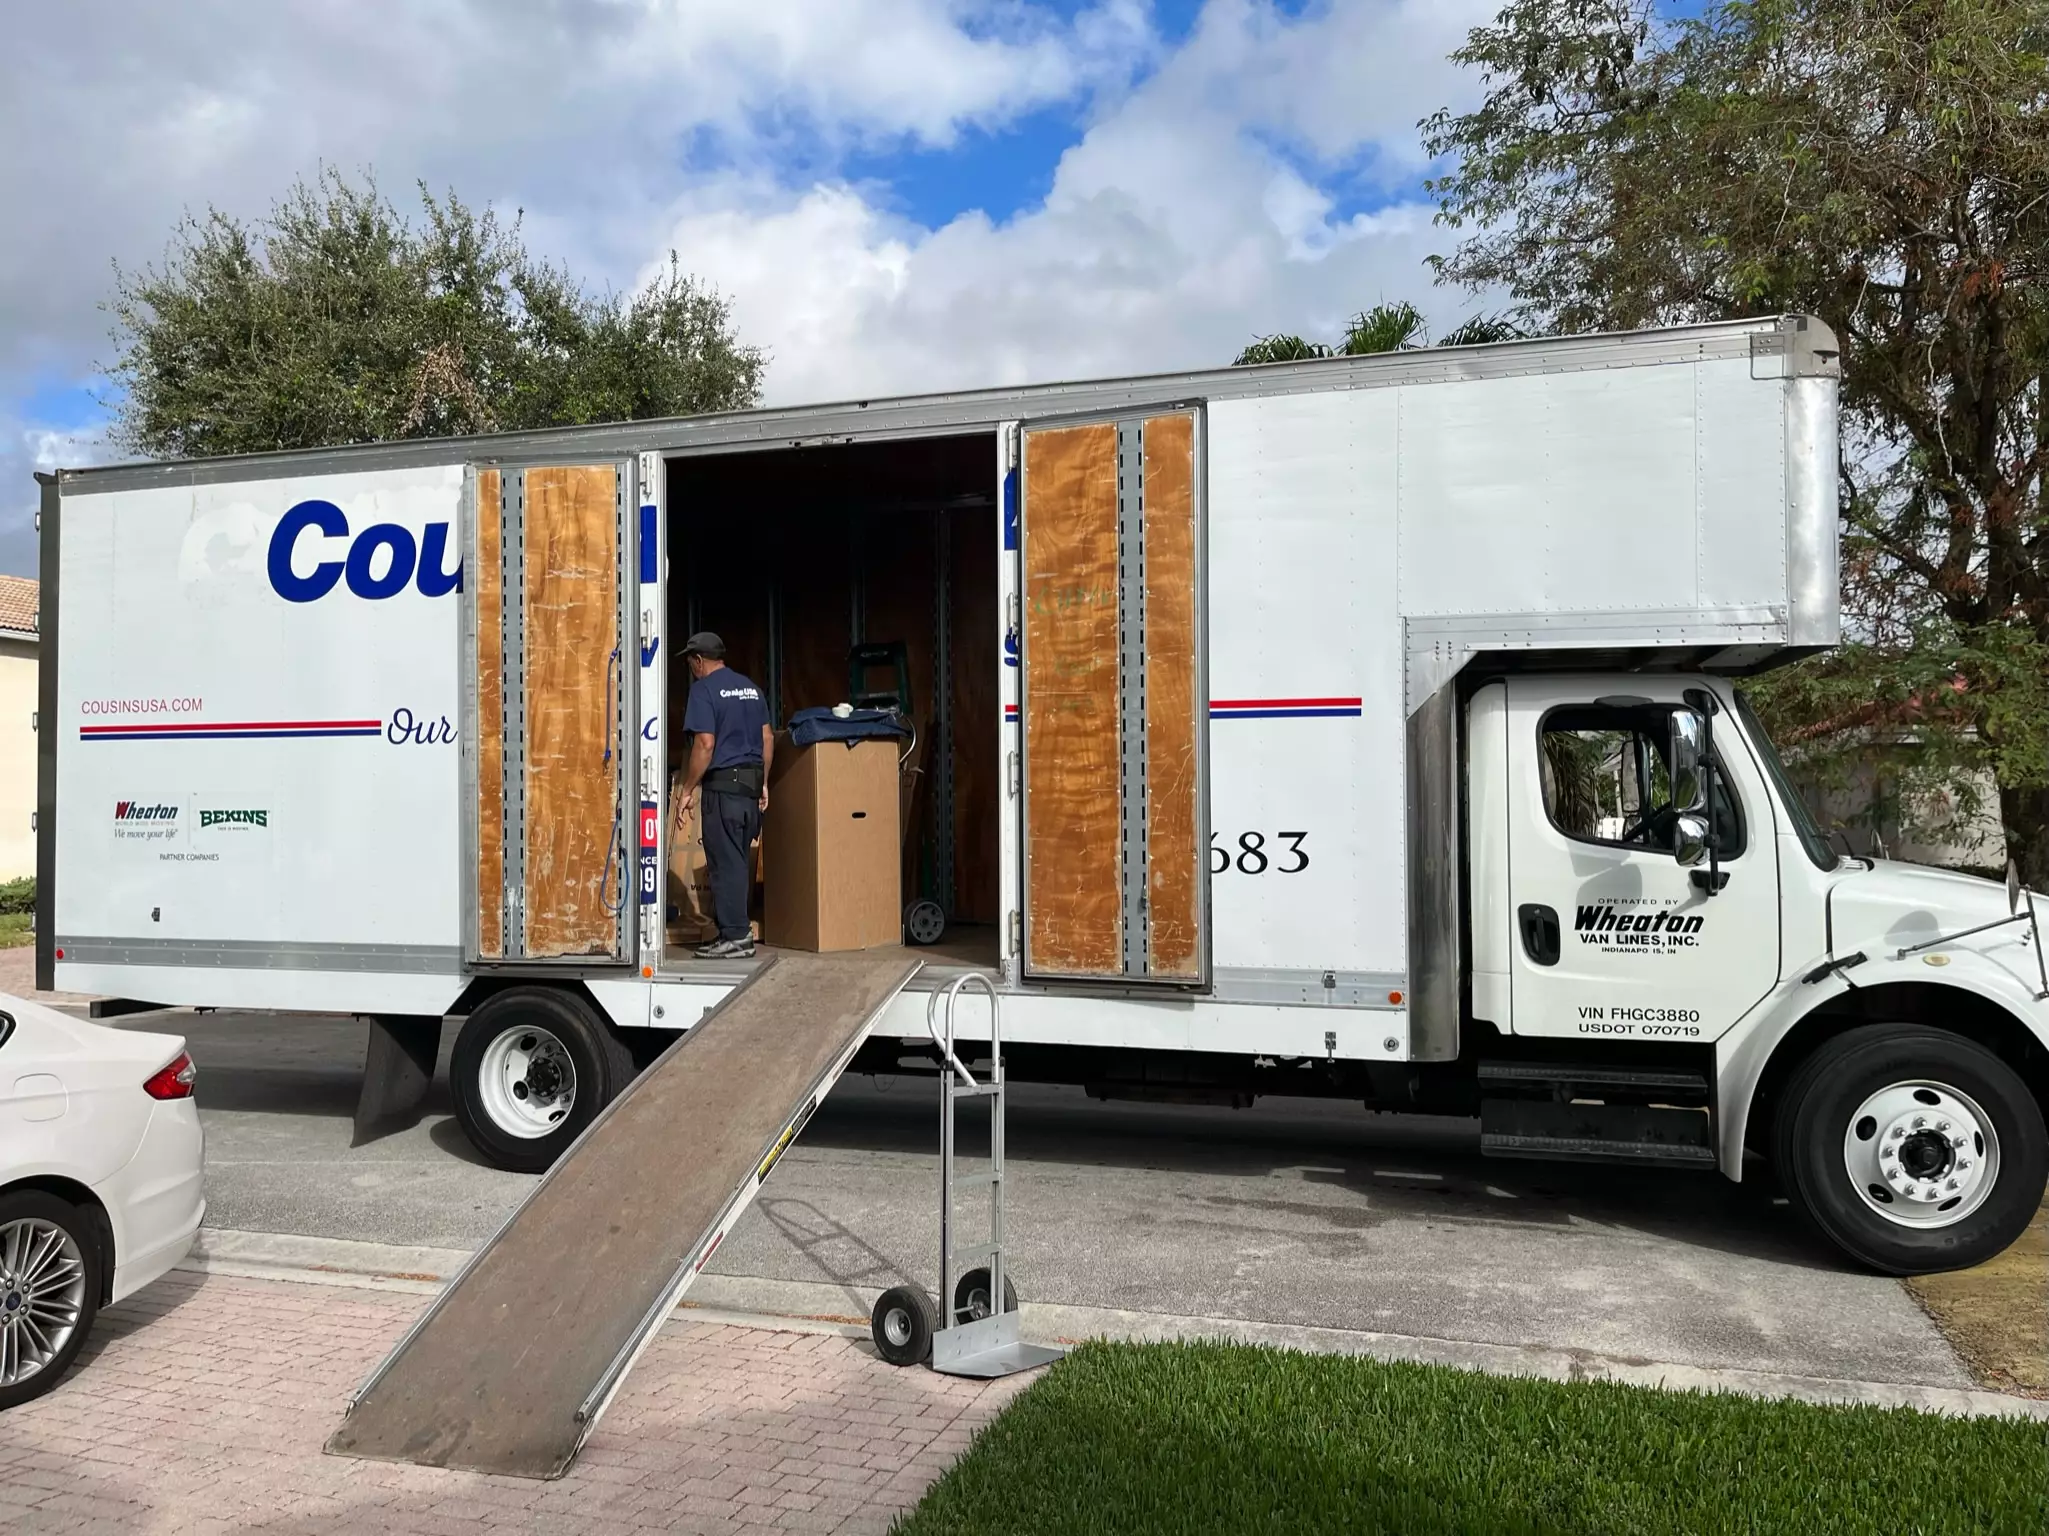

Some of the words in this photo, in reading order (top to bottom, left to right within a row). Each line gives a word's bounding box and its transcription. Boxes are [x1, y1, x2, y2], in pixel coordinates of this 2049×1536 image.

[81, 698, 203, 715] COUSINSUSA.COM
[387, 707, 458, 745] Our
[115, 801, 179, 820] Wheaton
[199, 809, 268, 828] BEKINS
[114, 828, 126, 838] We
[146, 831, 164, 841] your
[645, 818, 657, 840] O
[159, 853, 185, 861] PARTNER
[186, 853, 220, 861] COMPANIES
[640, 866, 655, 893] 9
[1597, 897, 1657, 905] OPERATED
[1574, 905, 1705, 933] Wheaton
[1580, 933, 1609, 944] VAN
[1578, 1006, 1604, 1019] VIN
[1611, 1007, 1700, 1022] FHGC3880
[1578, 1023, 1636, 1034] USDOT
[1641, 1025, 1700, 1036] 070719
